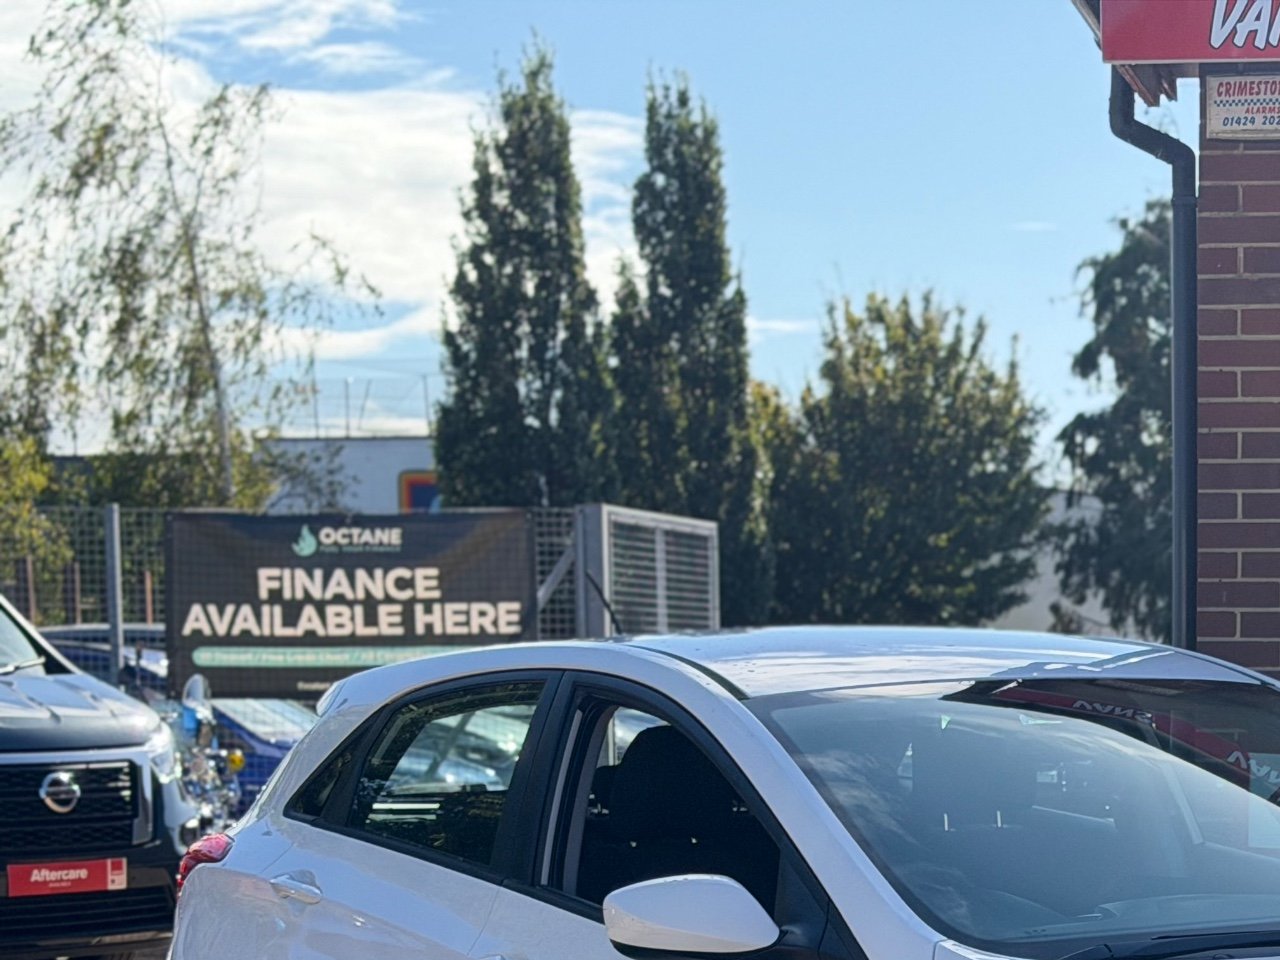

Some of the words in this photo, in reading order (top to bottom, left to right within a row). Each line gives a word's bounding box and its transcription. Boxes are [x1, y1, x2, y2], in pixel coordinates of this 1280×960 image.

[1222, 116, 1256, 127] 01424
[319, 526, 402, 545] OCTANE
[256, 567, 441, 601] FINANCE
[181, 603, 405, 638] AVAILABLE
[414, 602, 522, 636] HERE
[30, 868, 88, 882] Aftercare
